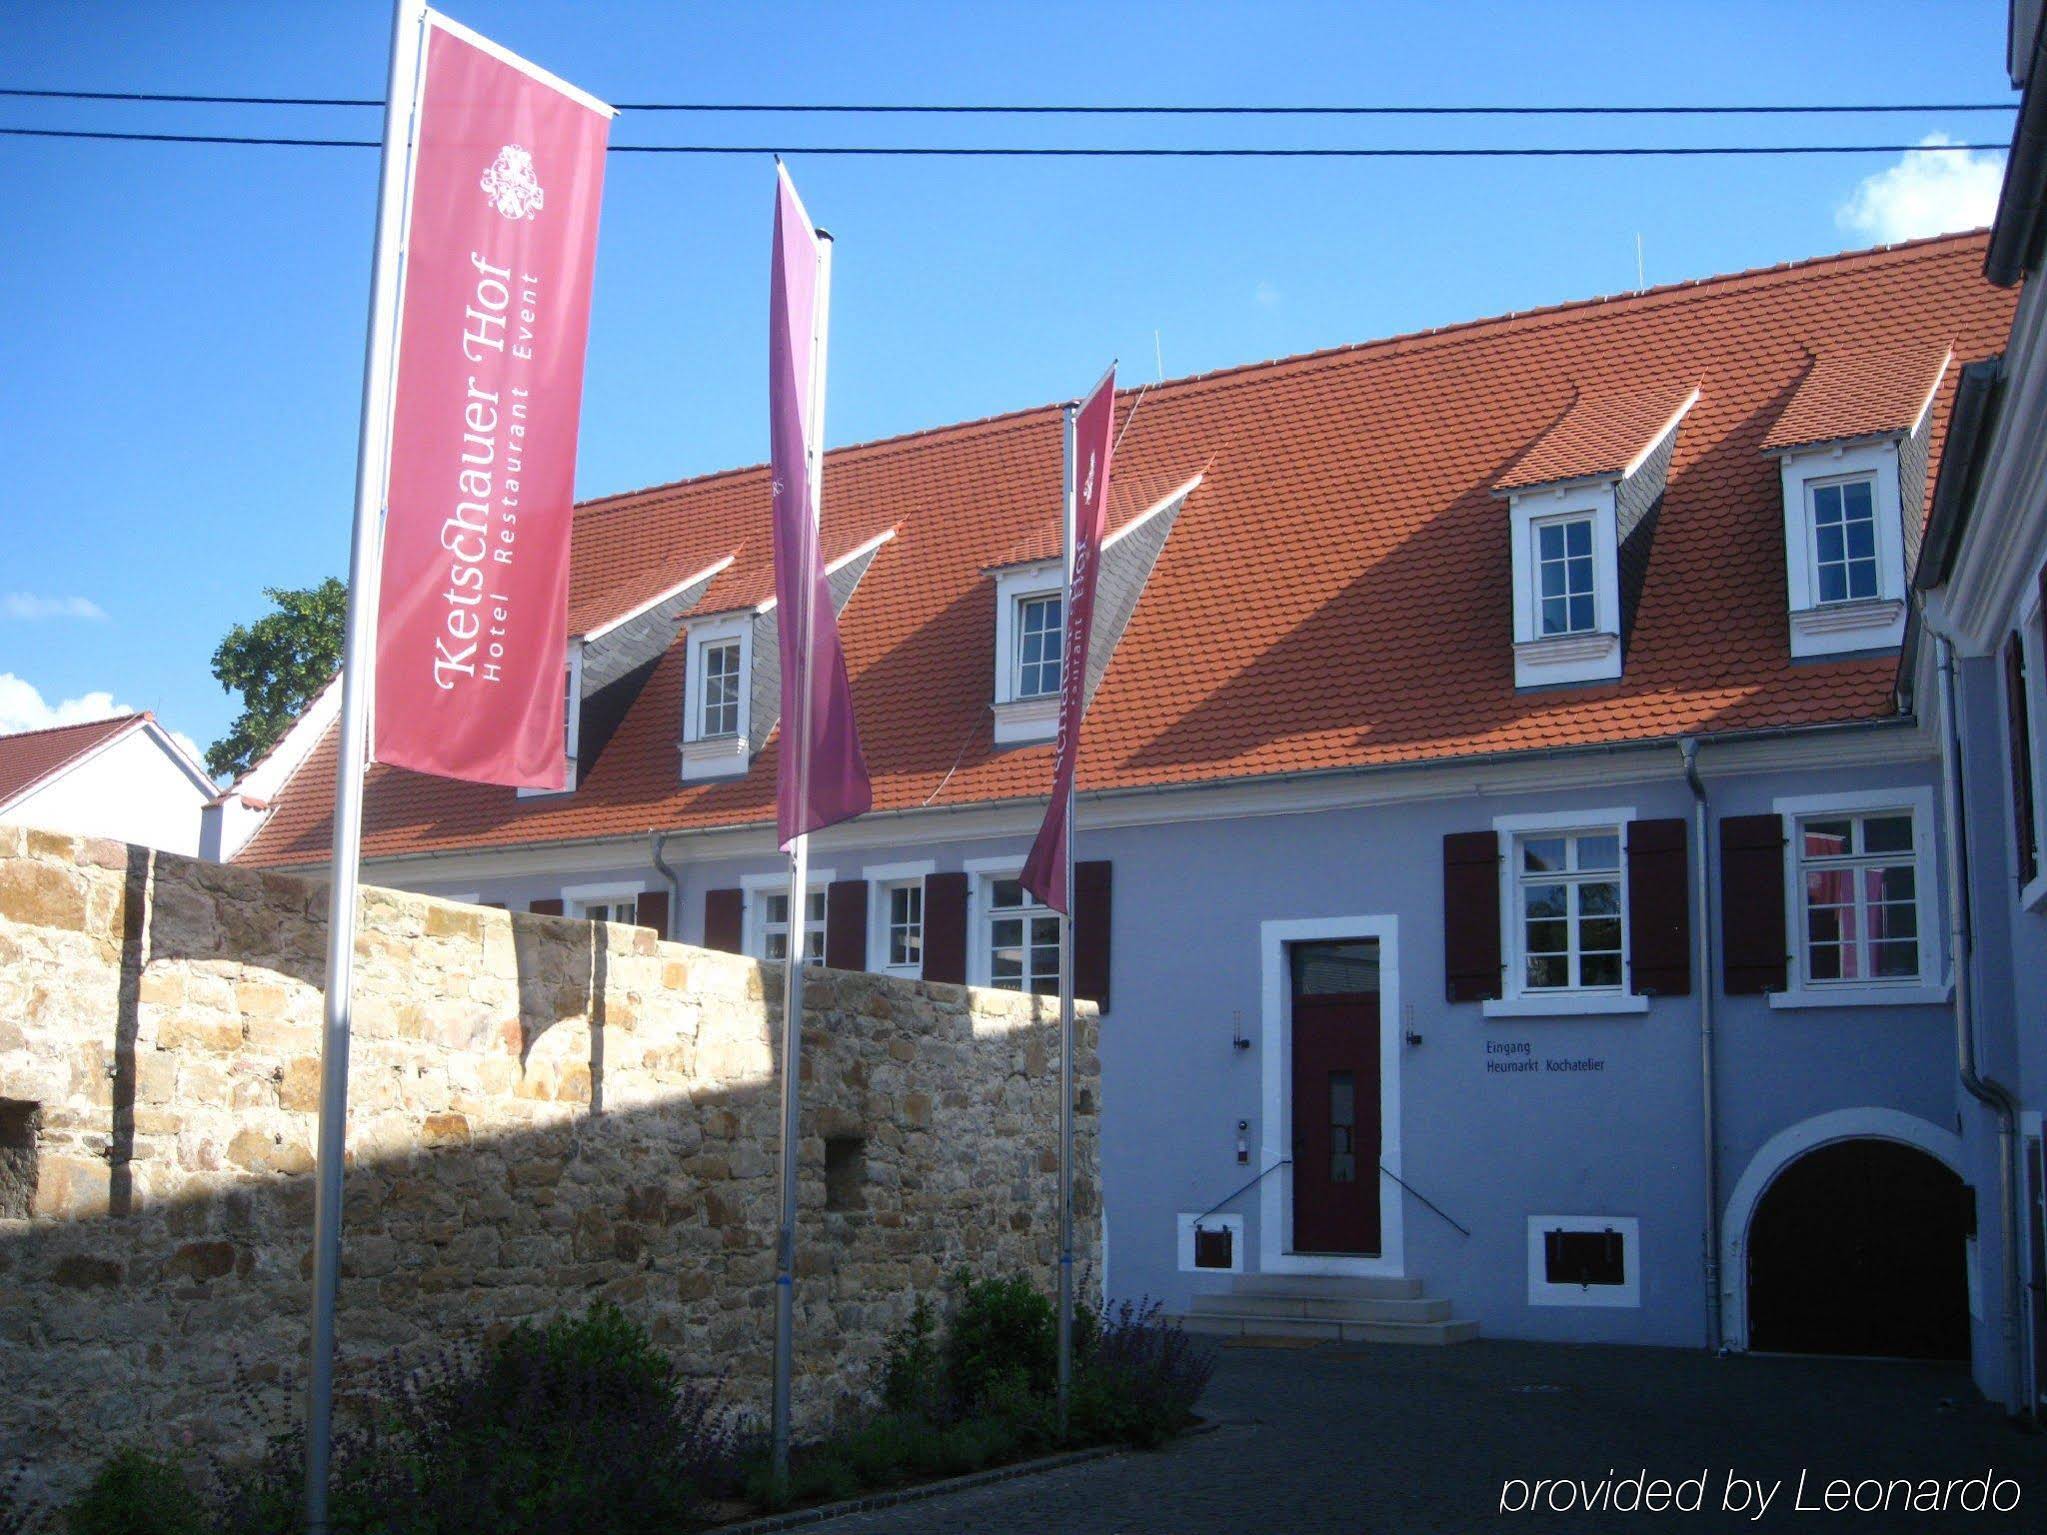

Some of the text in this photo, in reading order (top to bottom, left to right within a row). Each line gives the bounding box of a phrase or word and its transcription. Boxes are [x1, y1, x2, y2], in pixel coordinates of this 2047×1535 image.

[434, 251, 511, 690] Ketschauer Hof
[482, 272, 538, 682] Hotel Restaurant Event
[1486, 1040, 1531, 1056] Eingang
[1486, 1059, 1605, 1073] Heumarkt Kochatelier
